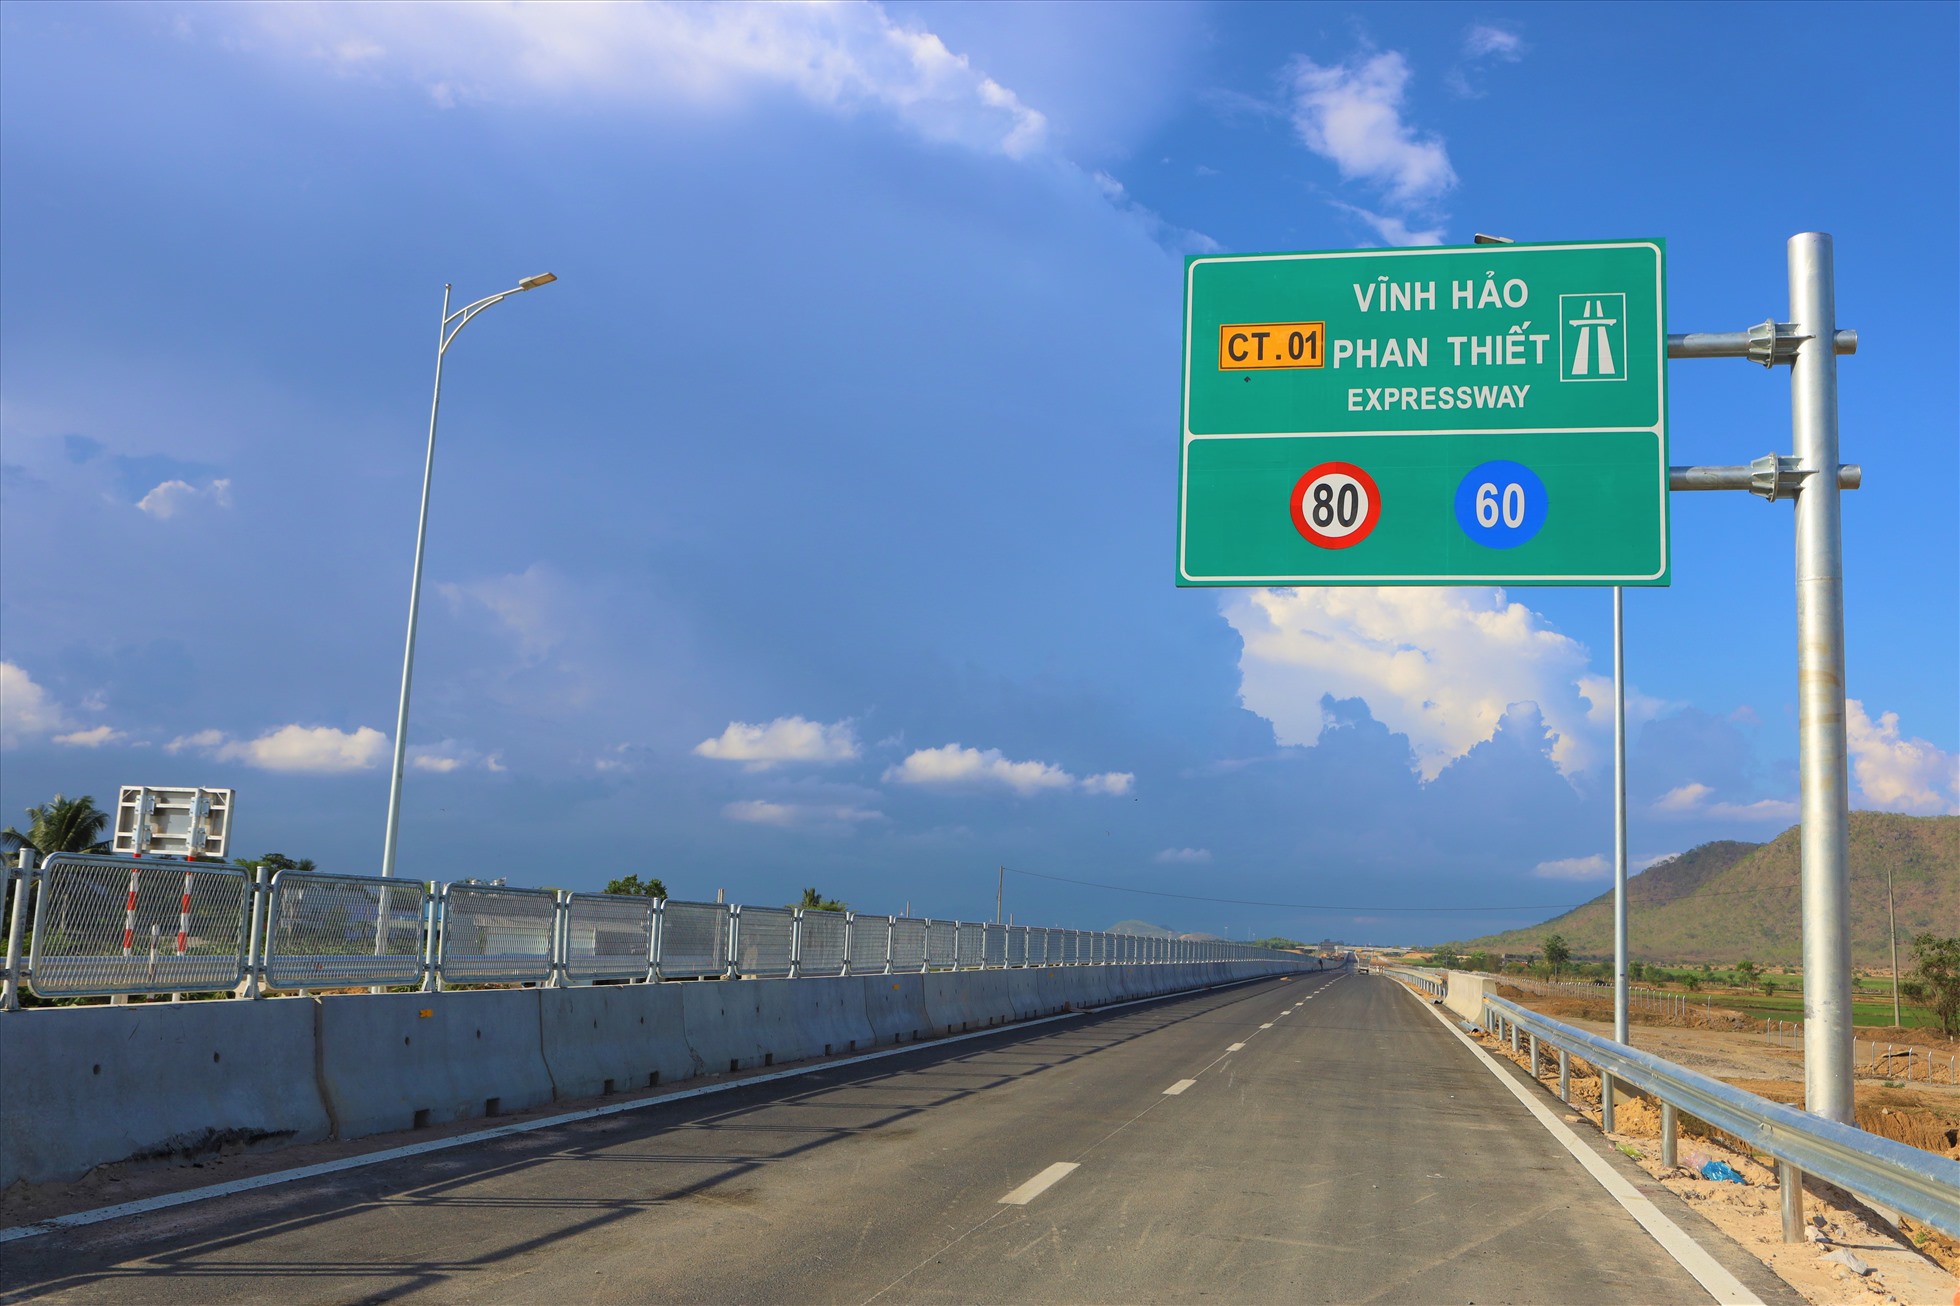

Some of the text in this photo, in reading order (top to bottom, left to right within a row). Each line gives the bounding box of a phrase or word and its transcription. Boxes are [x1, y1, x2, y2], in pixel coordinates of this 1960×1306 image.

[1354, 271, 1528, 312] VĨNH HẢO
[1334, 322, 1549, 368] PHAN THIẾT
[1349, 385, 1530, 410] EXPRESSWAY
[1313, 484, 1358, 527] 80
[1476, 483, 1524, 528] 60
